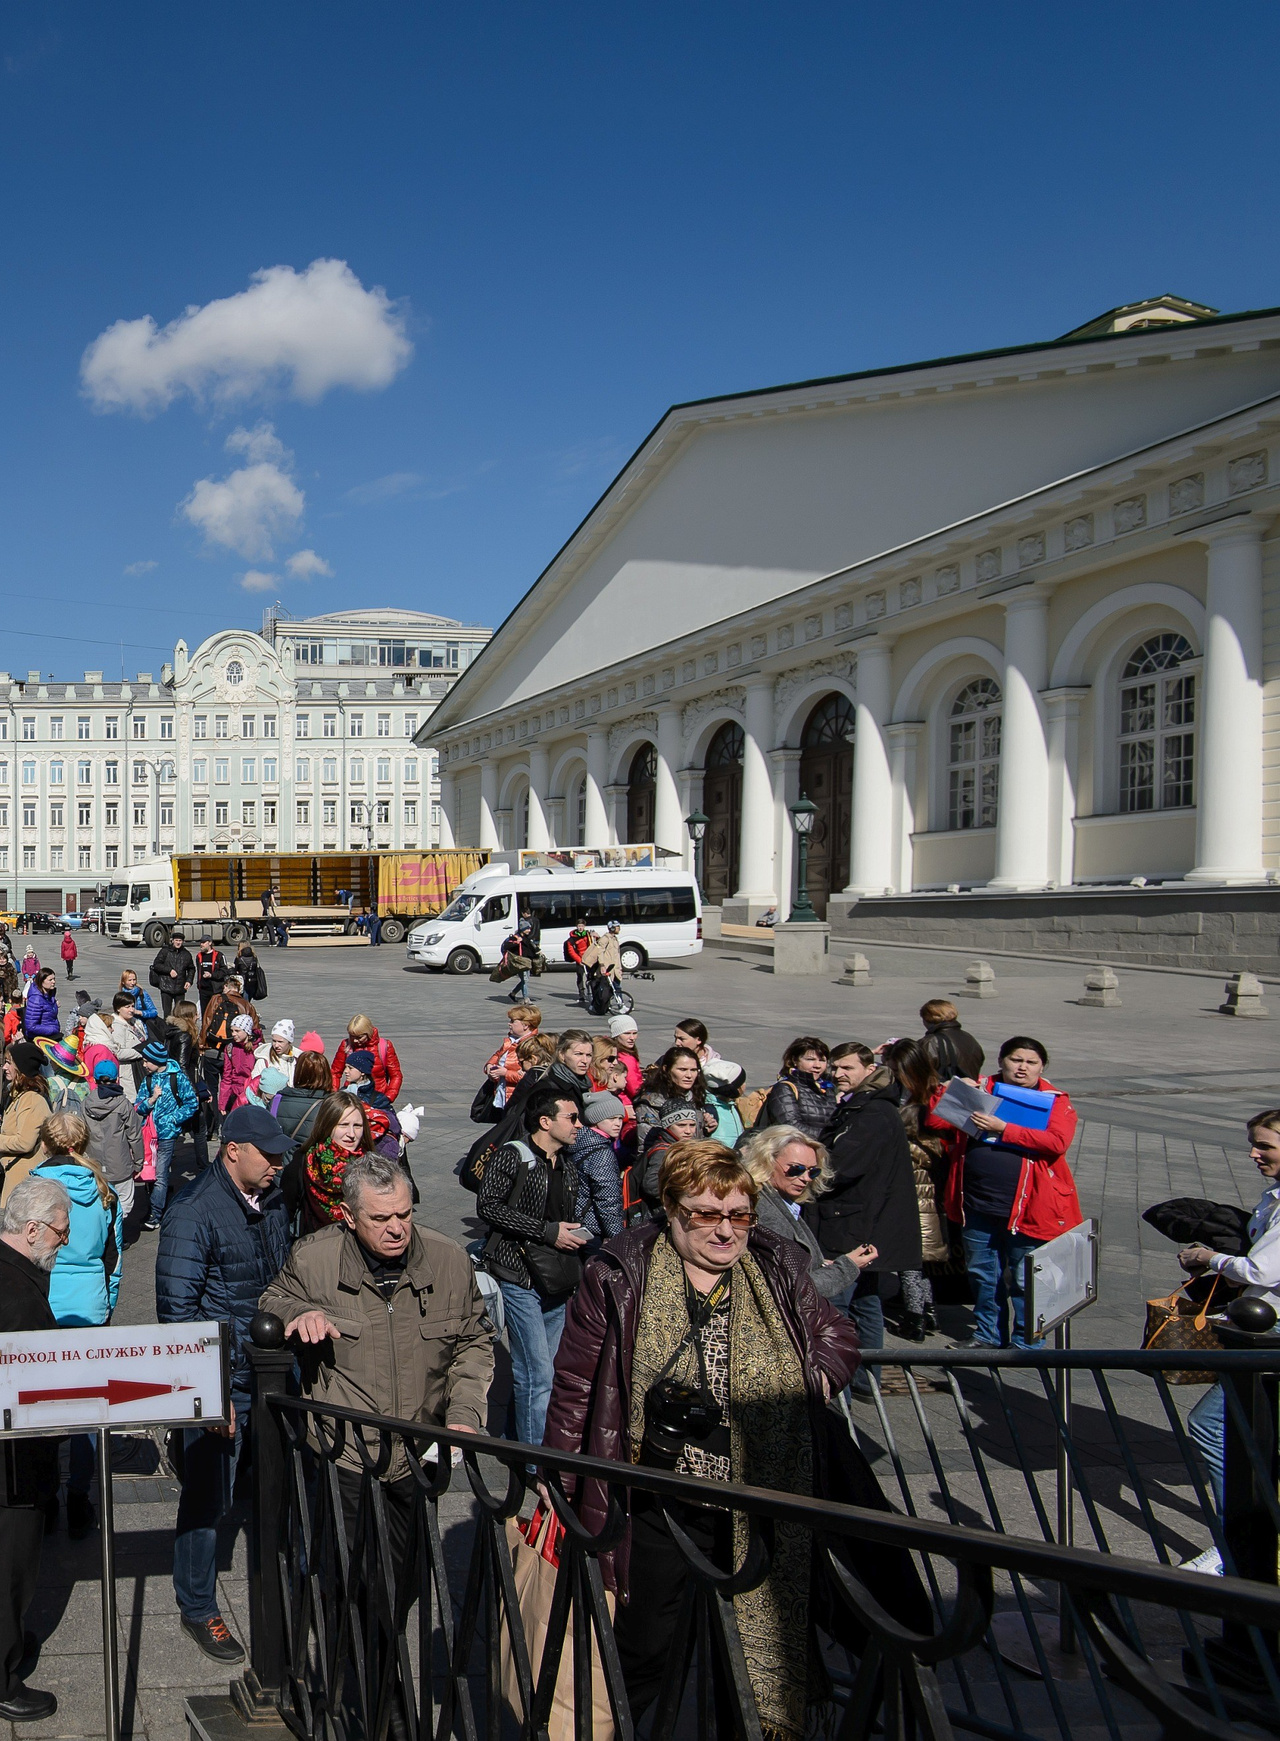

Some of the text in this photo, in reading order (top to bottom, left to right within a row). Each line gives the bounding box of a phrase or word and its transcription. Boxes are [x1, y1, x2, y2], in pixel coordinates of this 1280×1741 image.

[709, 1285, 725, 1307] Nikon
[62, 1349, 81, 1361] НА
[86, 1345, 148, 1360] СЛУЖБУ
[152, 1345, 163, 1356] В
[166, 1342, 206, 1355] ХРАМ
